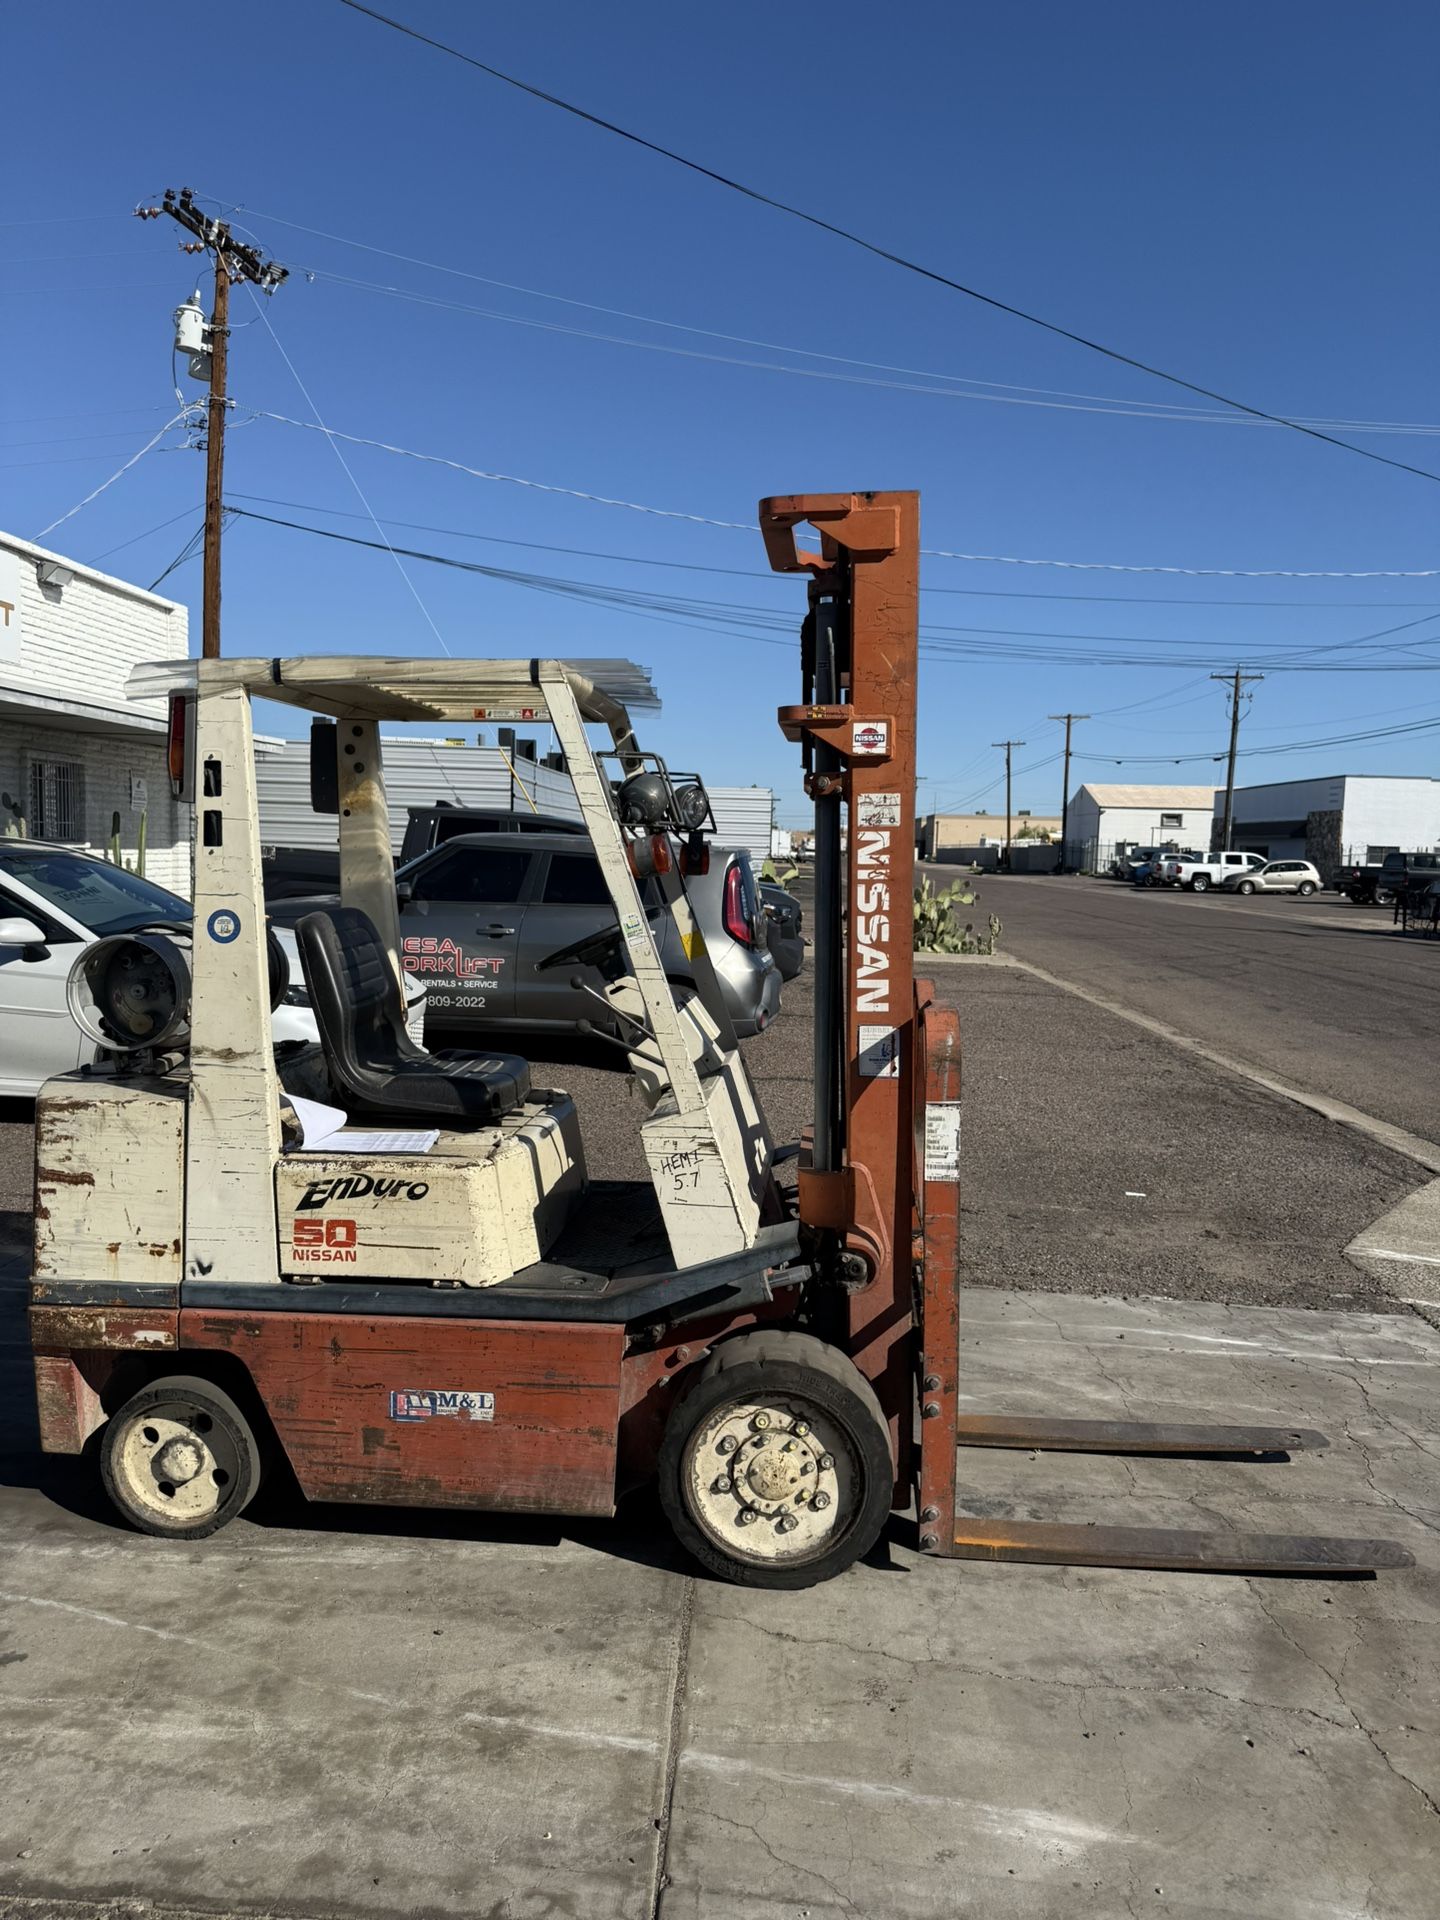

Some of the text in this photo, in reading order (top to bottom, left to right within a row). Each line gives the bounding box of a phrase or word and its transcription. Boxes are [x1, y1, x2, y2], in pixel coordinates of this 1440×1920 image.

[855, 734, 884, 742] NISSAN
[857, 831, 890, 1012] NISSAN
[400, 937, 457, 953] ESA
[401, 947, 505, 978] ORKLIFT
[464, 981, 498, 989] SERVICE
[293, 1218, 357, 1247] 50
[293, 1249, 357, 1262] NISSAN
